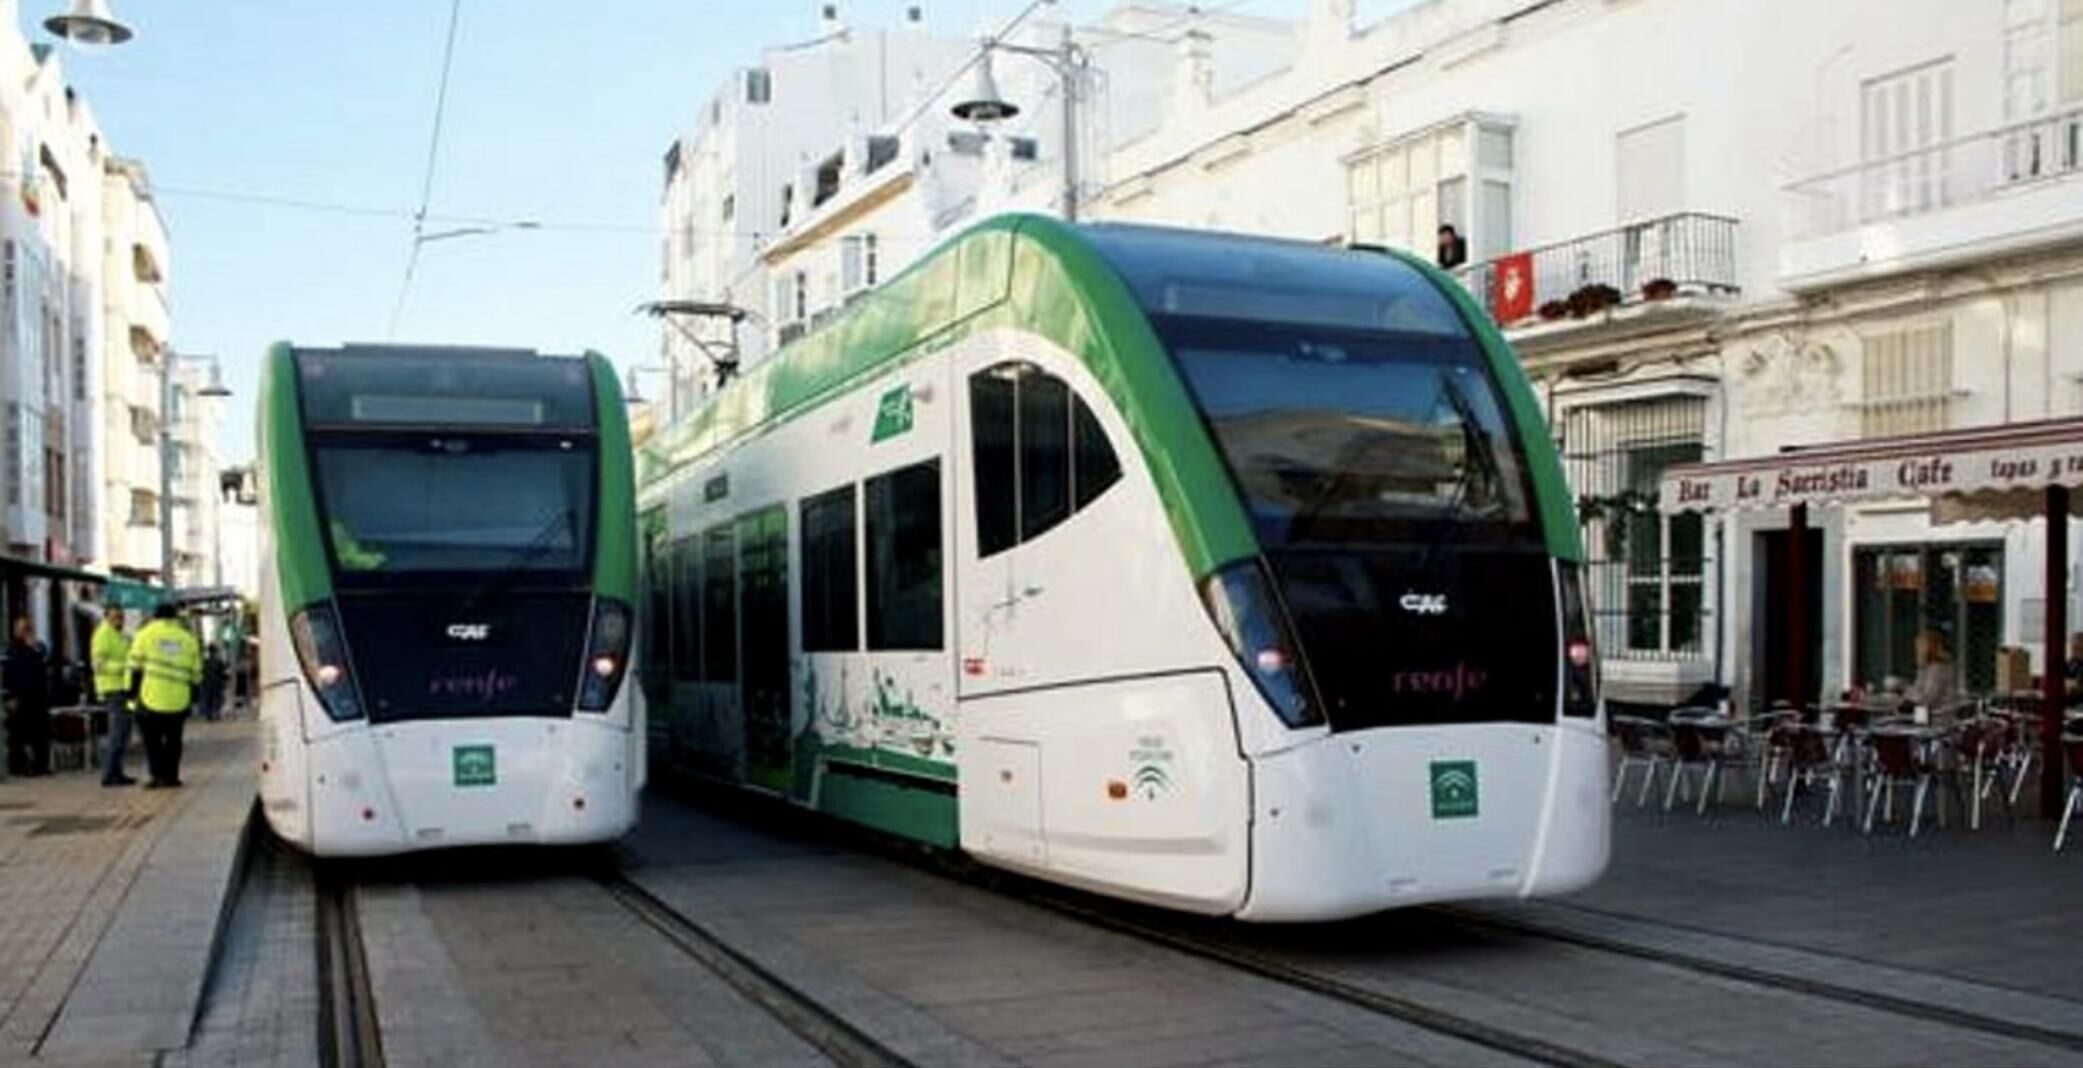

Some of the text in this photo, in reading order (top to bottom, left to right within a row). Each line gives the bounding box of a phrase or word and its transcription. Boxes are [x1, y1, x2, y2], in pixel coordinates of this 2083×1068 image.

[1678, 478, 1711, 502] Bar
[1737, 475, 1761, 498] La
[1991, 459, 2037, 480] tapas
[429, 666, 518, 701] renfe
[1394, 660, 1487, 701] renfe
